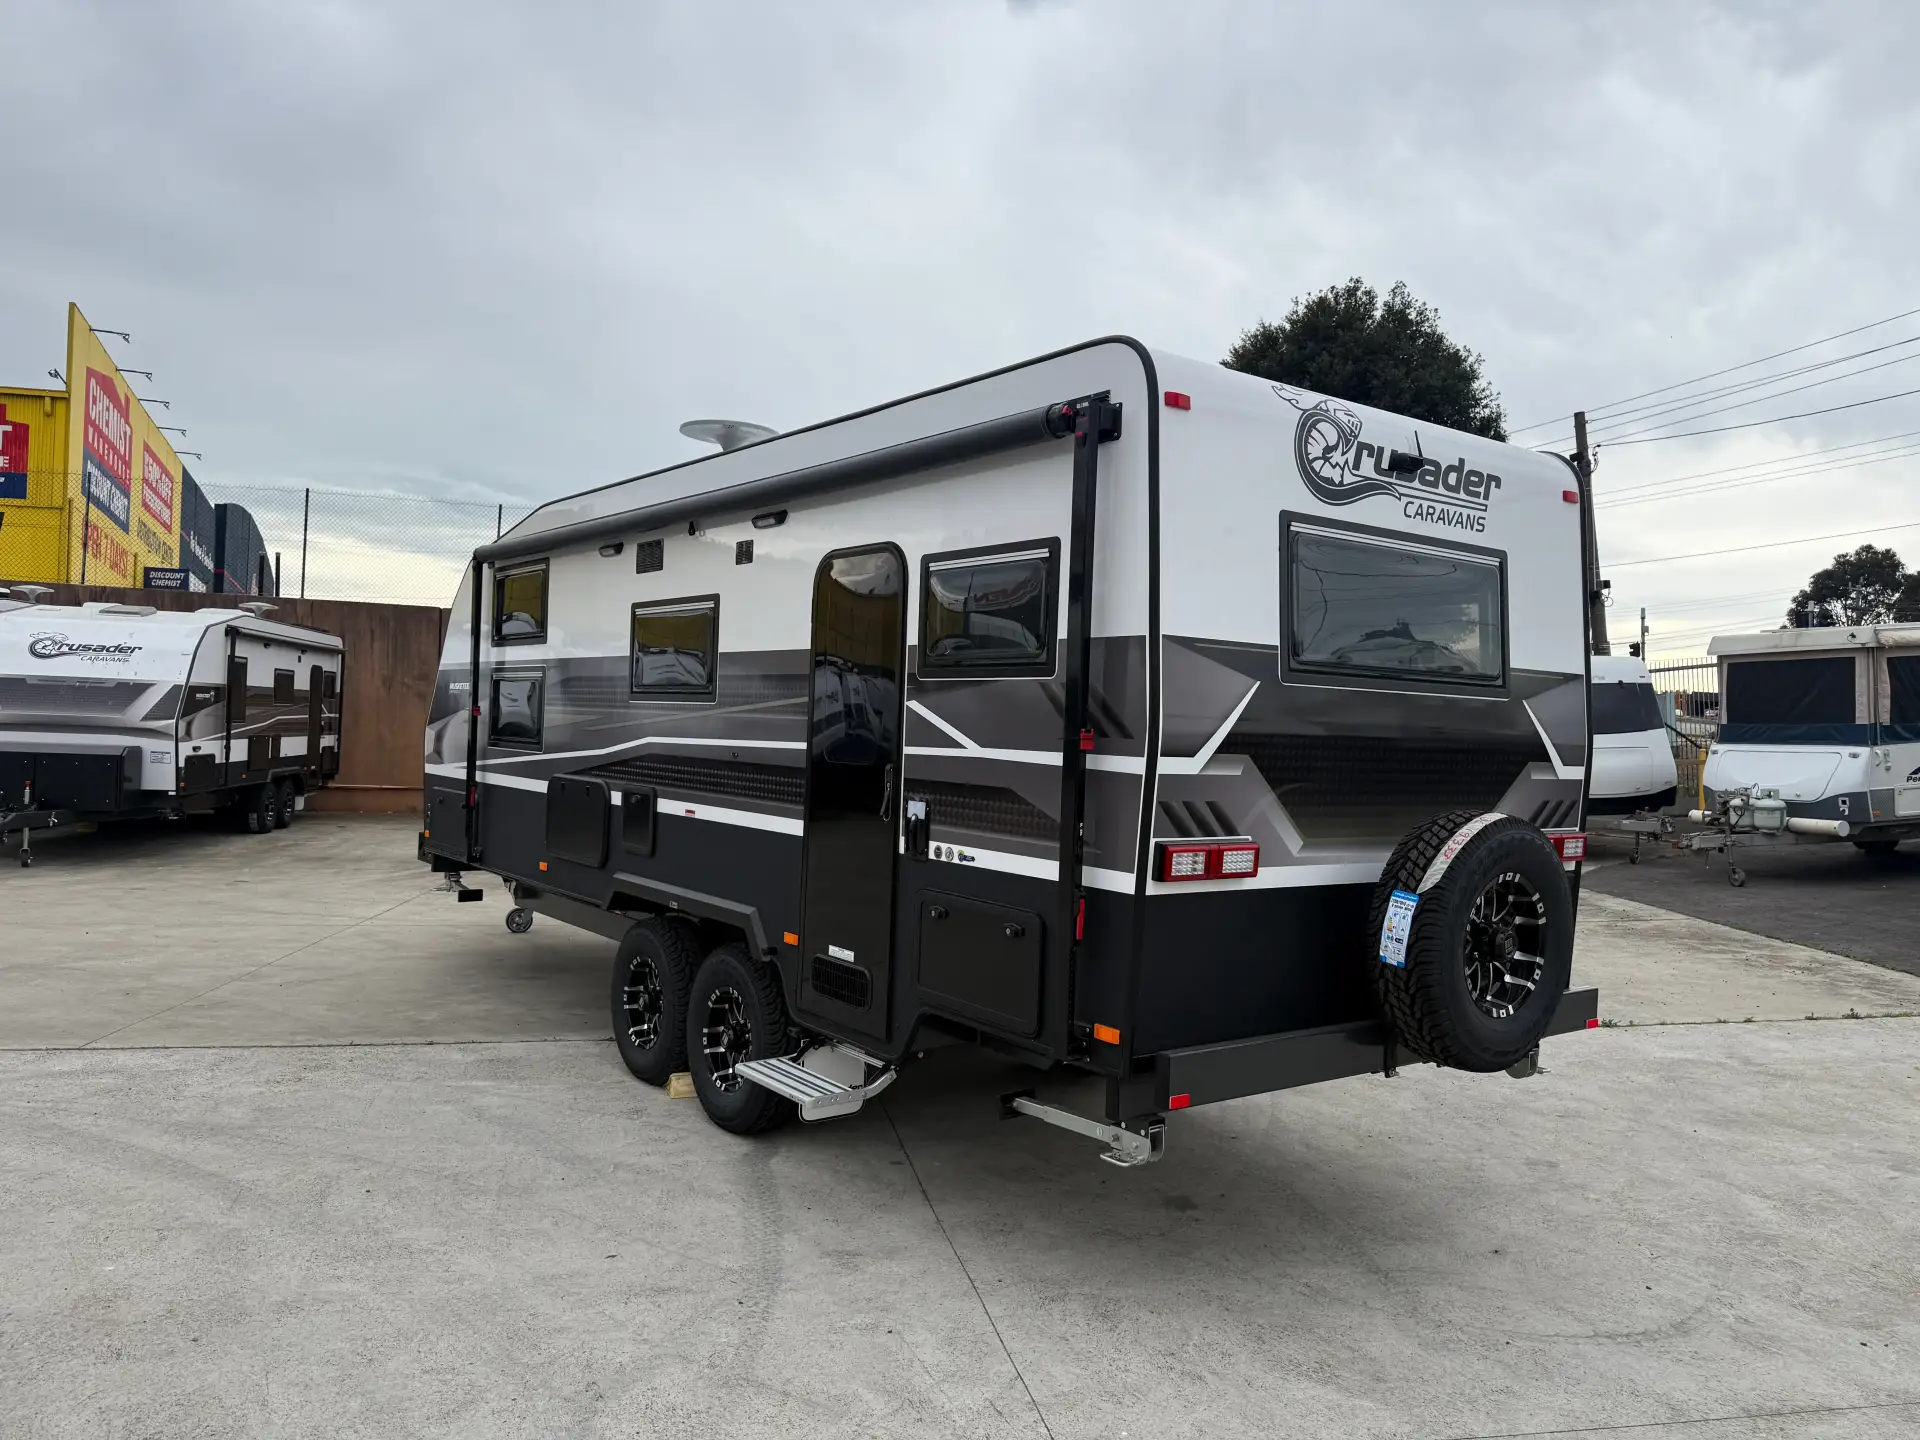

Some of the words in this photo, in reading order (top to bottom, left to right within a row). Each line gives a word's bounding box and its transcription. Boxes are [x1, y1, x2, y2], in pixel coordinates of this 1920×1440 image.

[89, 376, 131, 460] CHEMIST
[88, 425, 130, 484] WAREHOUSE
[1403, 500, 1486, 533] CARAVANS
[149, 571, 186, 580] DISCOUNT
[151, 579, 182, 587] CHEMIST
[28, 633, 143, 660] Crusader
[80, 655, 131, 663] CARAVANS
[1906, 775, 1920, 783] Pe
